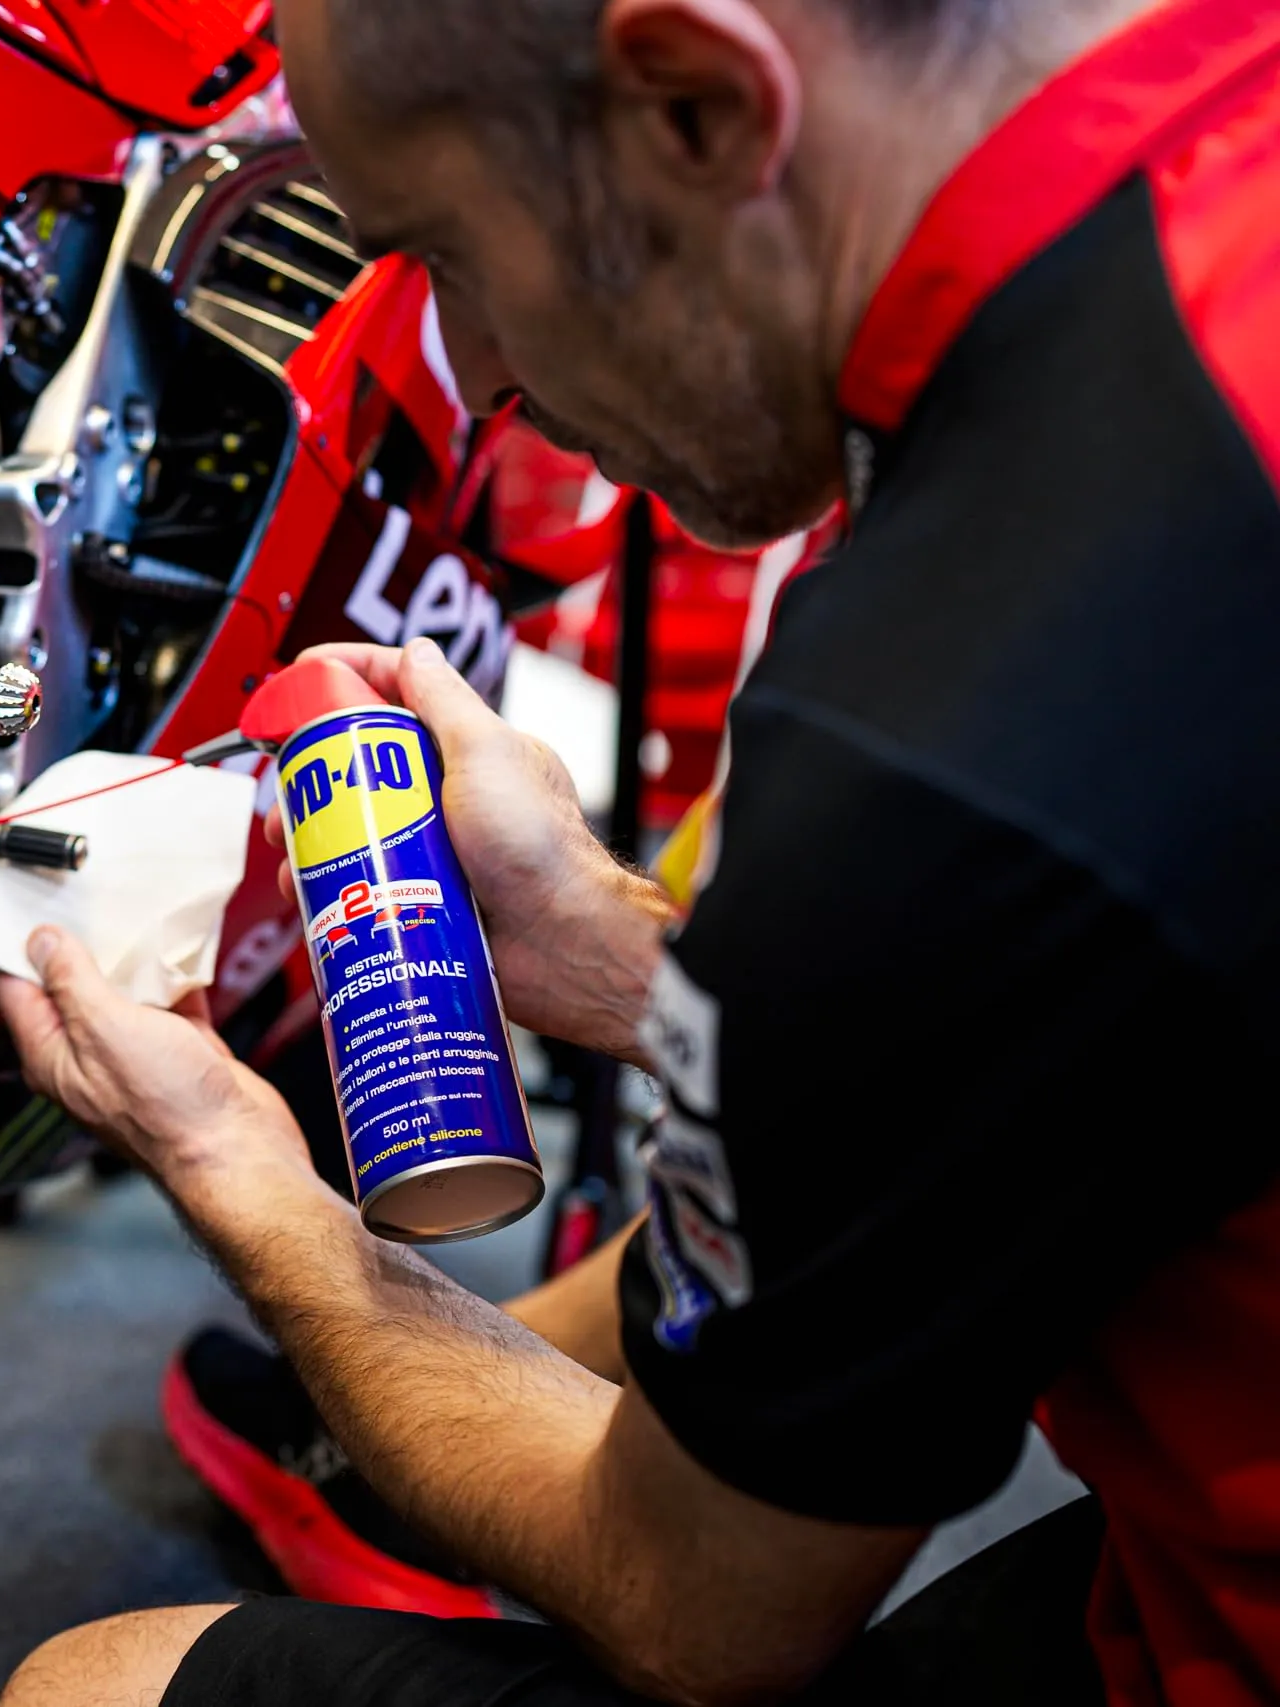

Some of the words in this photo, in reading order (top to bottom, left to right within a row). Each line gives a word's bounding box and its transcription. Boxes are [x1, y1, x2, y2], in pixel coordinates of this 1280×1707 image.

[338, 830, 415, 869] MULTIFNZIONE
[340, 881, 374, 922] 2
[344, 950, 404, 979] SISTEMA
[321, 959, 468, 1024] PROFESSIONALE
[350, 1007, 387, 1031] Arresta
[395, 996, 430, 1012] cigolii
[350, 1026, 385, 1050] Elimina
[354, 1058, 361, 1067] e
[361, 1037, 411, 1065] protegge
[413, 1031, 443, 1044] dalla
[444, 1030, 486, 1042] ruggine
[356, 1062, 387, 1087] bulloni
[388, 1061, 397, 1070] e
[399, 1056, 410, 1067] le
[412, 1049, 440, 1065] parti
[443, 1048, 500, 1062] arrugginite
[370, 1067, 437, 1098] meccanismi
[439, 1066, 485, 1077] bloccati
[369, 1102, 409, 1126] precauzioni
[409, 1099, 418, 1107] di
[382, 1118, 409, 1139] 500
[411, 1112, 431, 1129] ml
[357, 1159, 373, 1178] Non
[373, 1135, 427, 1164] contiene
[428, 1127, 483, 1142] silicone
